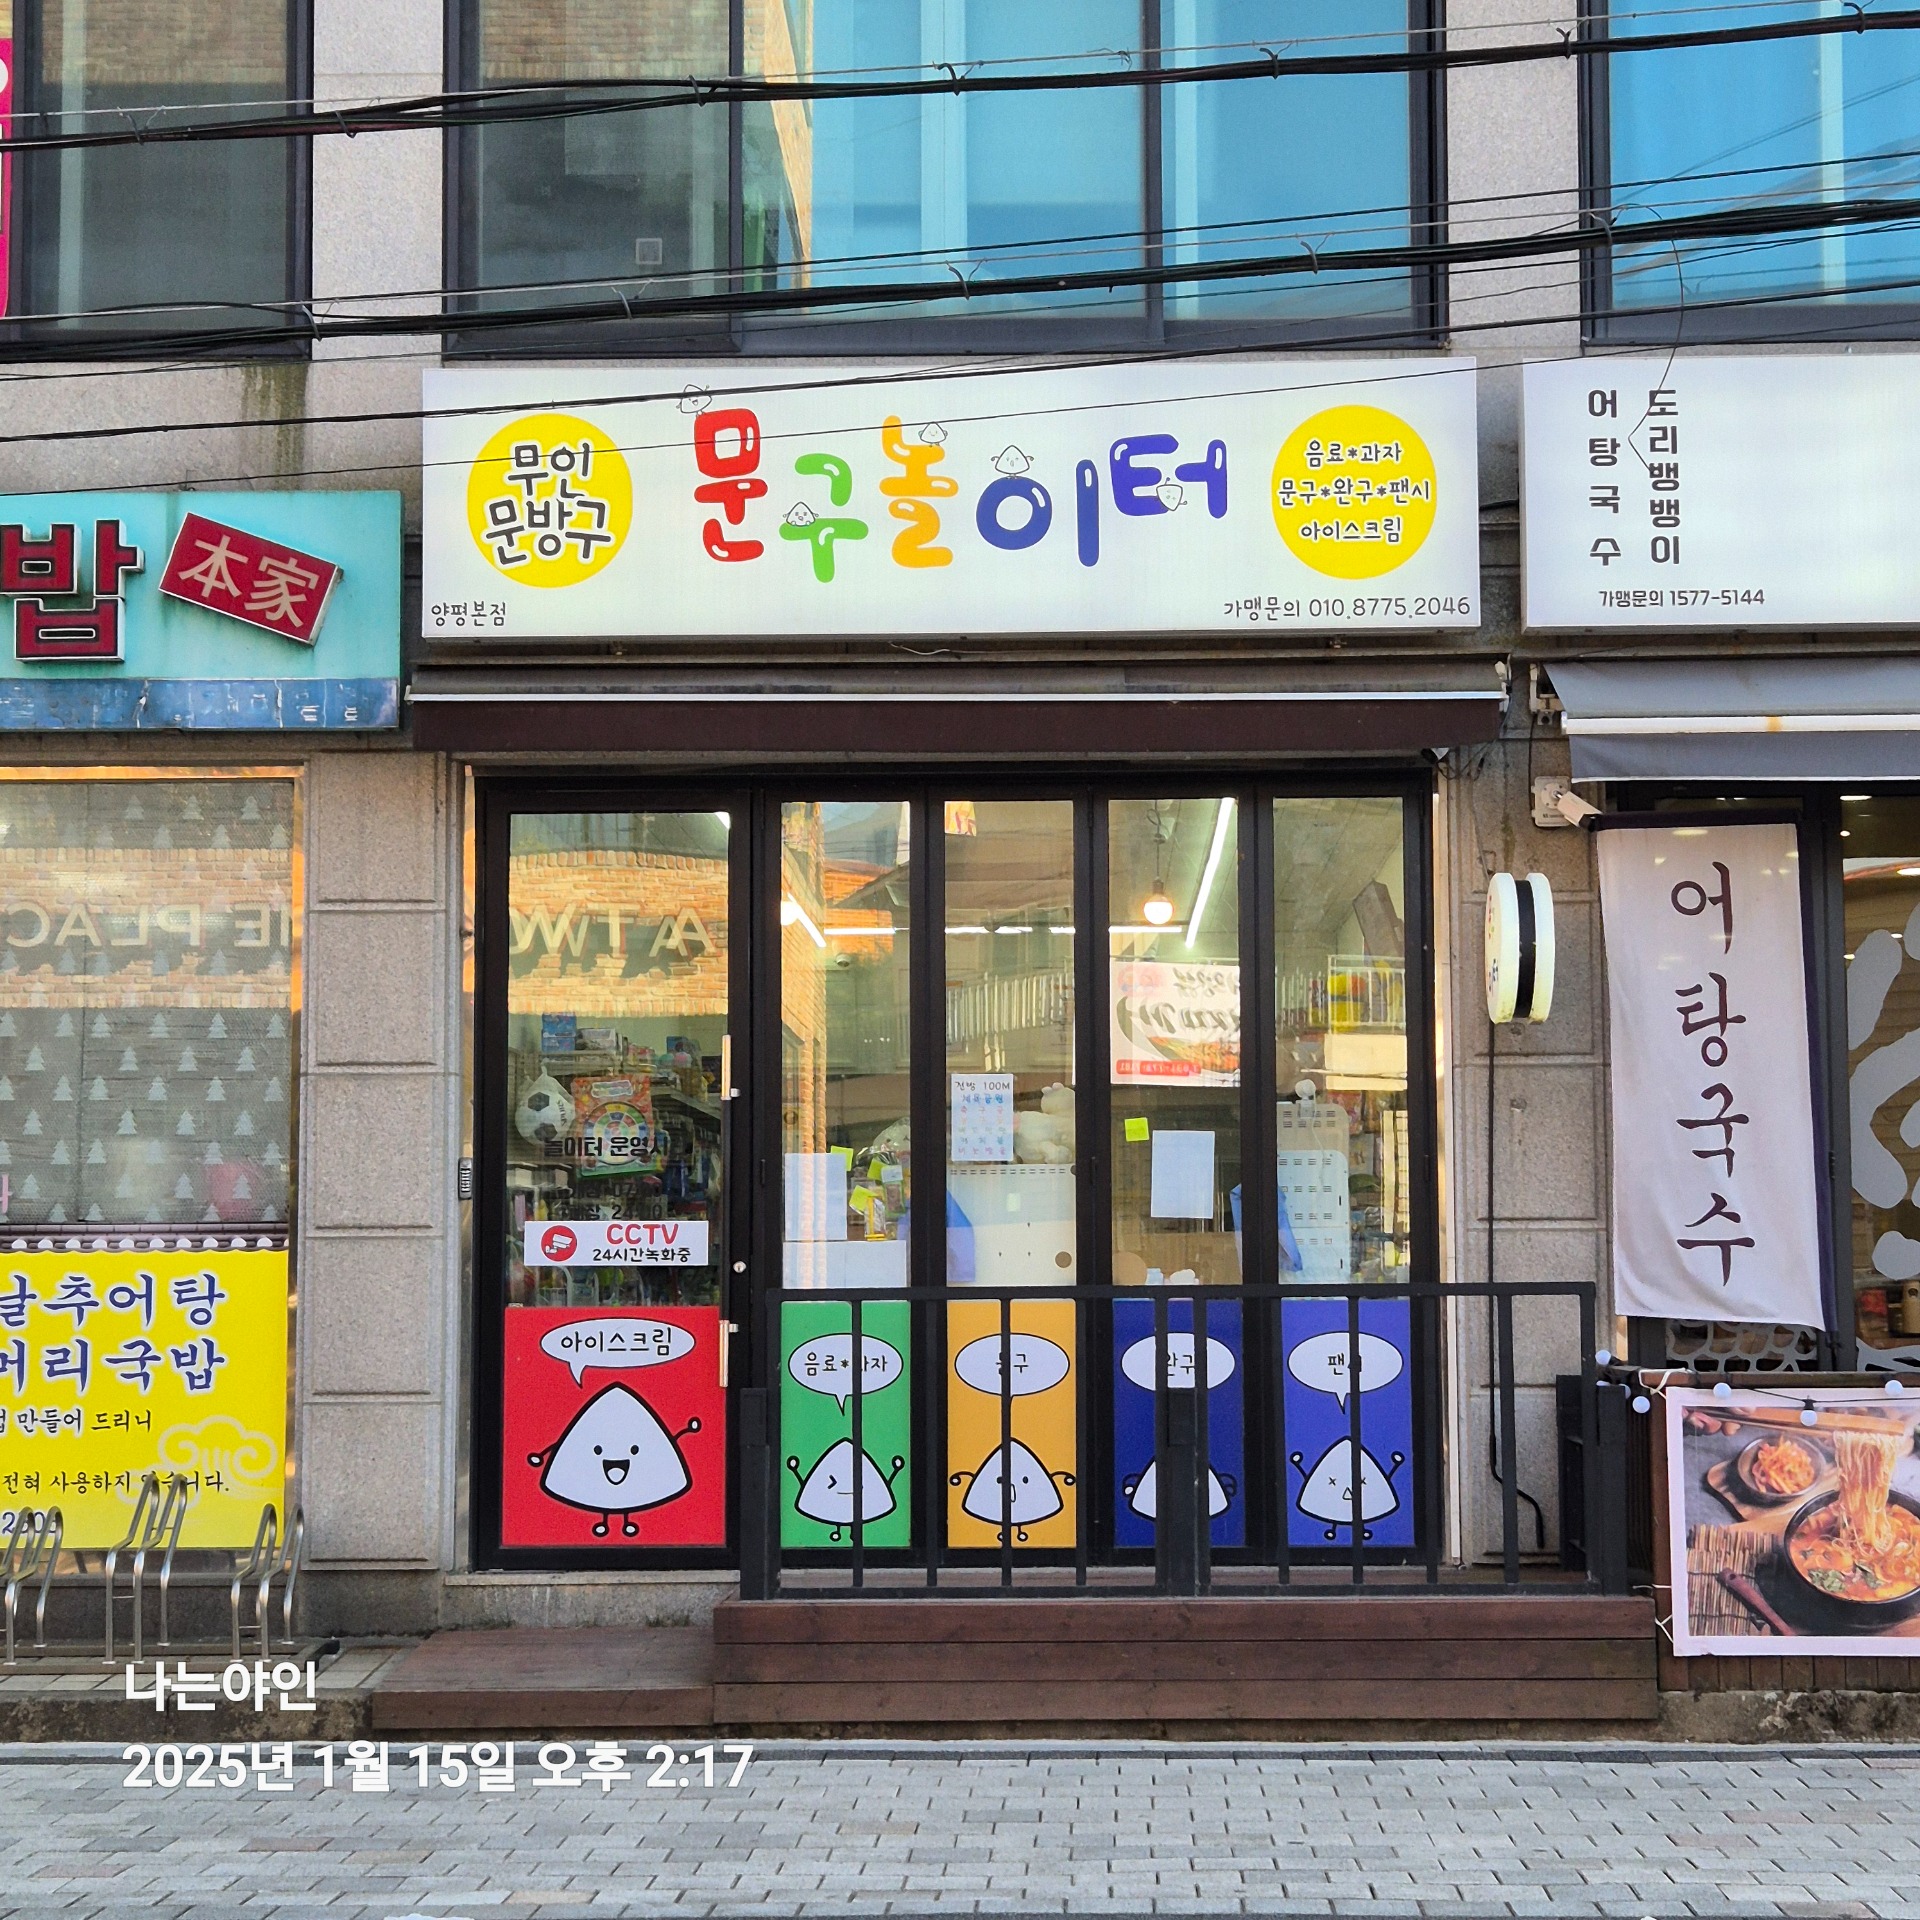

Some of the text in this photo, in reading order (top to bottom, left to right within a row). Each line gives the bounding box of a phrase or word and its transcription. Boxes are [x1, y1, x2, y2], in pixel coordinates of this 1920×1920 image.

[507, 442, 594, 498] 무인
[1588, 389, 1622, 566] 어탕국수
[1647, 389, 1681, 565] 도리뱅뱅이
[693, 407, 1227, 583] 문구놀이터
[484, 498, 612, 564] 문방구
[1301, 516, 1401, 543] 아이스크림
[0, 518, 144, 663] 밥
[178, 534, 320, 629] 本家
[1224, 596, 1471, 621] 가맹문의 010.8775.2046
[1599, 589, 1765, 607] 가맹문의 1577-5144
[430, 601, 507, 627] 양평본점
[1670, 860, 1756, 1288] 어탕국수
[606, 1223, 679, 1245] CCTV
[592, 1247, 691, 1263] 24시간녹화중
[560, 1327, 672, 1356] 아이스크림
[17, 1408, 82, 1433] 만들어
[91, 1409, 152, 1433] 드리니
[2, 1471, 40, 1494] 전혀
[50, 1471, 130, 1494] 사용하지
